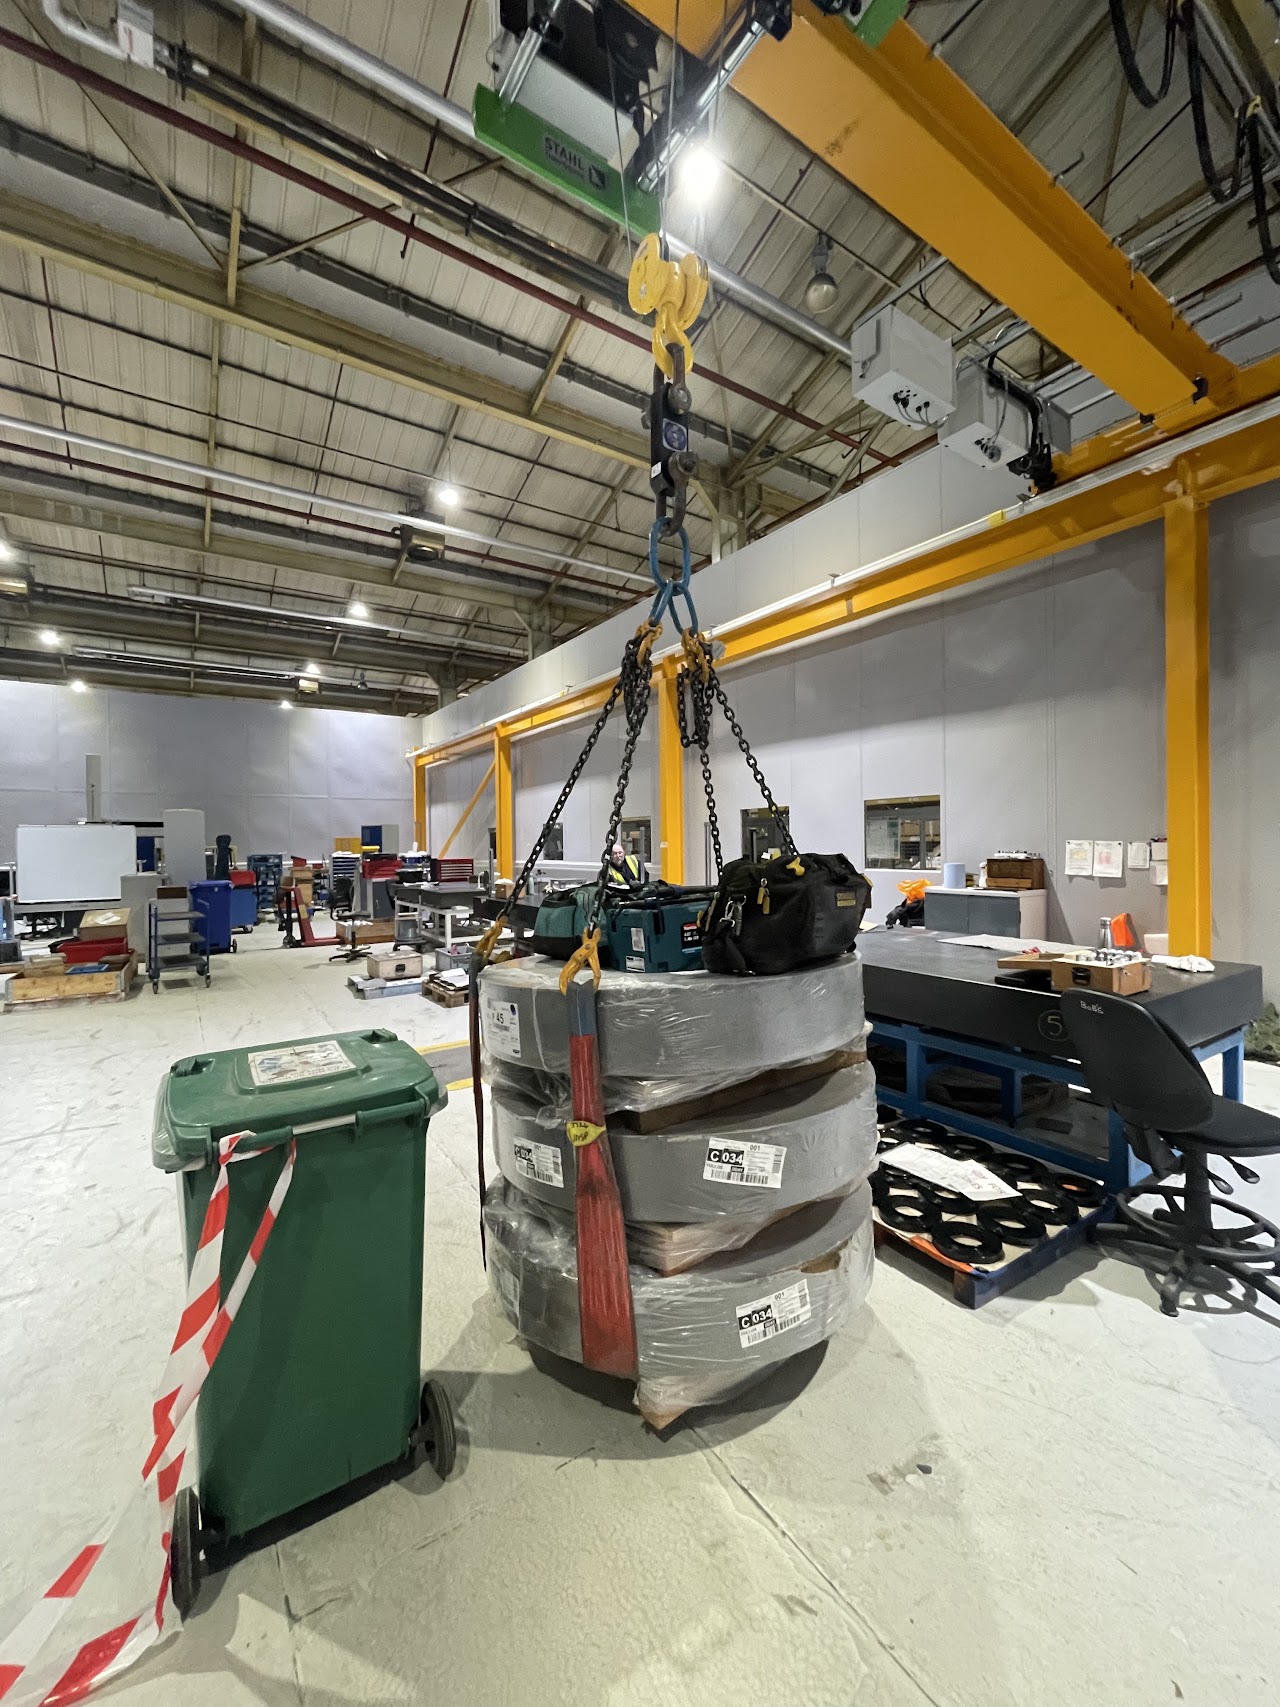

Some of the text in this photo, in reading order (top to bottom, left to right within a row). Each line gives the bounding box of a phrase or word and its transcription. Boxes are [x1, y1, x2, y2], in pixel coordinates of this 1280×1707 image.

[545, 137, 585, 170] STAHL
[1047, 1015, 1063, 1037] 5
[710, 1151, 743, 1164] C 034
[741, 1317, 750, 1328] C
[752, 1308, 772, 1323] 034
